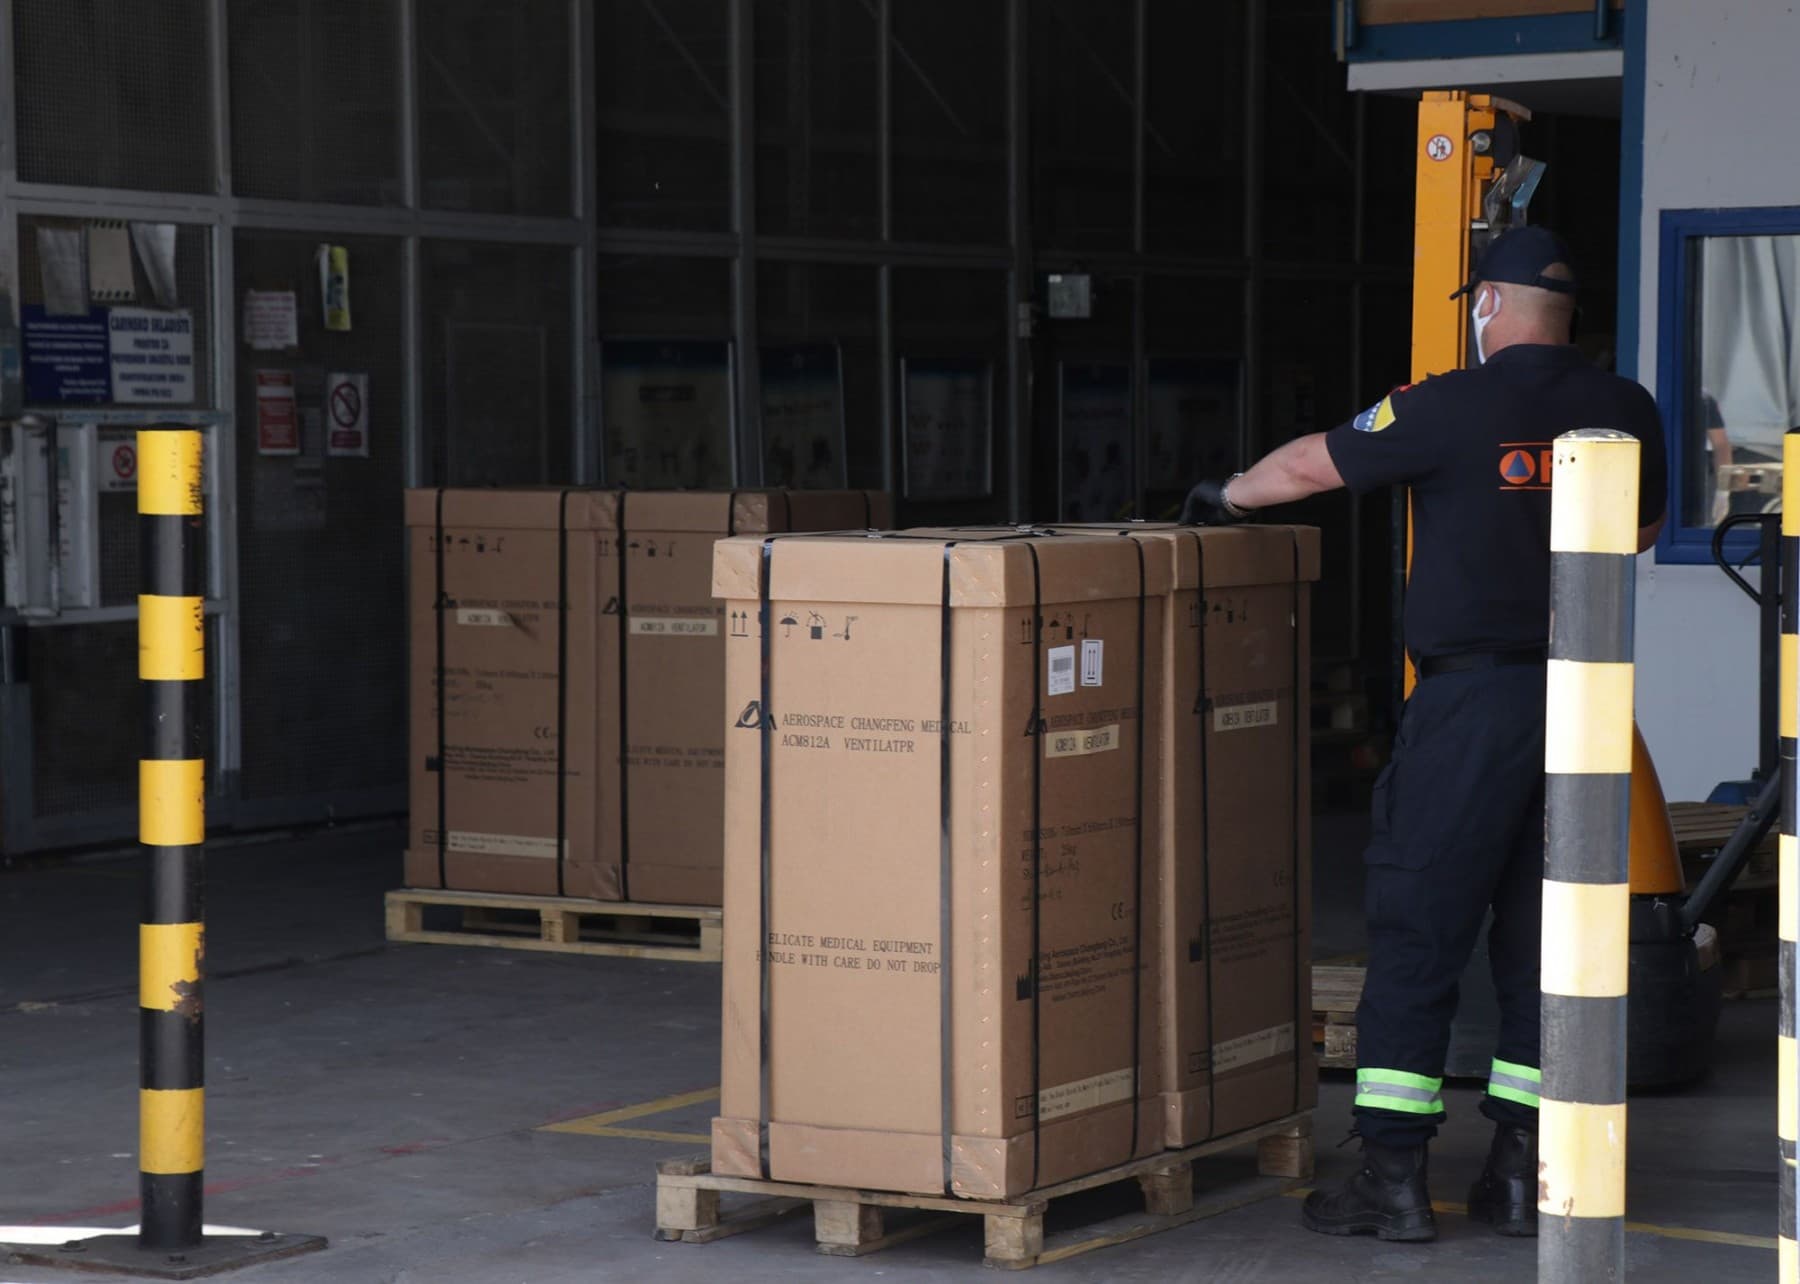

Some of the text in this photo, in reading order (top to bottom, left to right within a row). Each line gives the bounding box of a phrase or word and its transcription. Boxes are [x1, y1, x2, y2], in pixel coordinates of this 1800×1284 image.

[782, 713, 972, 734] AEROSPACE CHANGFENG MEDCAL
[782, 734, 915, 753] ACM812A VENTILATPR
[769, 933, 933, 955] ELICATE MEDICAL EQUIPMENT
[756, 950, 942, 974] HNDLE WITH CARE DO NOT DROP
